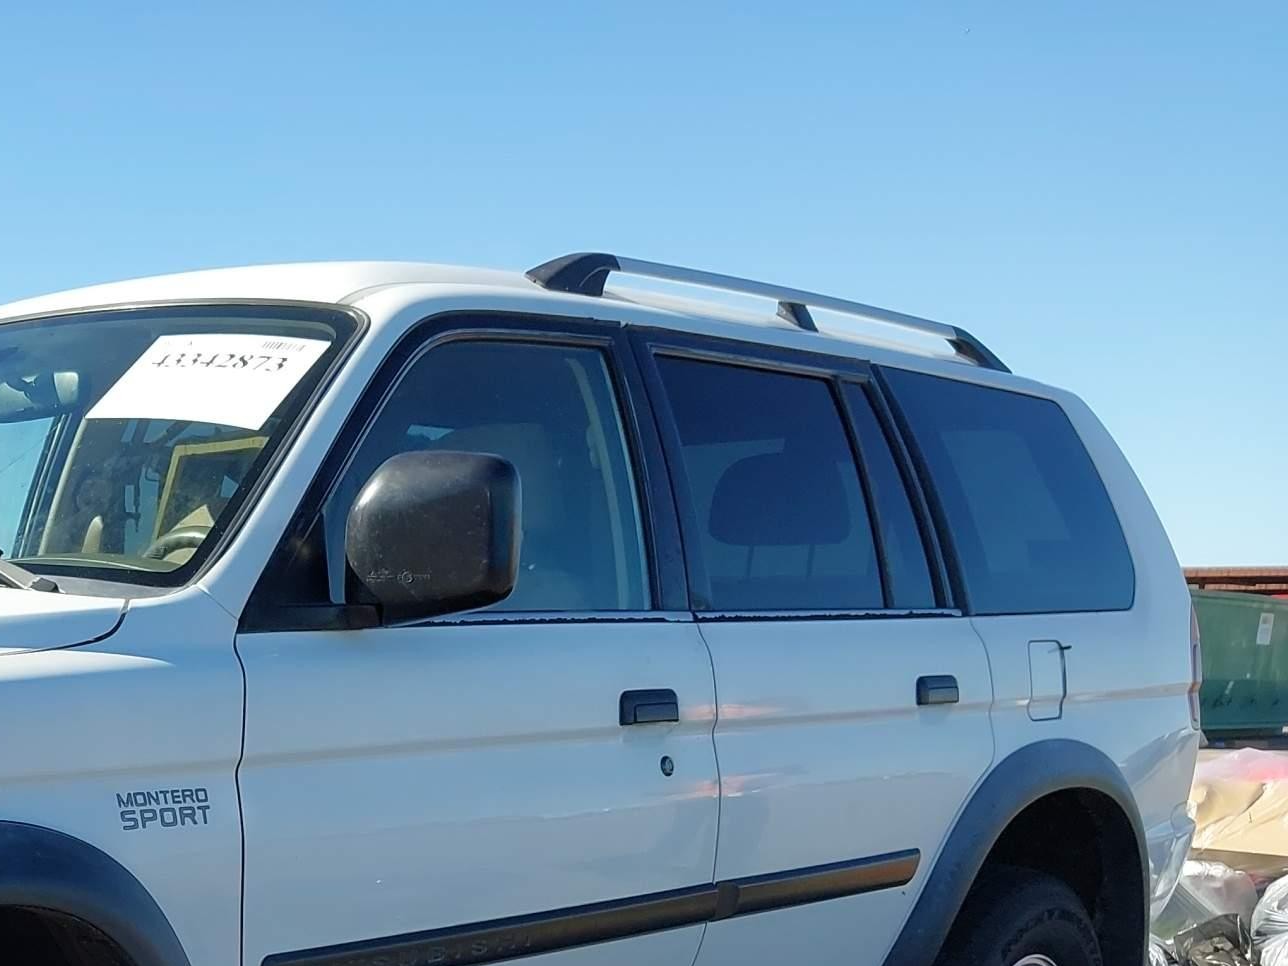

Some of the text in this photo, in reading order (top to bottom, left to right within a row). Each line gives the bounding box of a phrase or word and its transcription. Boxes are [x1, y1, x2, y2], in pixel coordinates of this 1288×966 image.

[151, 352, 289, 372] 43342873
[116, 788, 209, 808] MONTERO
[120, 805, 211, 831] SPORT
